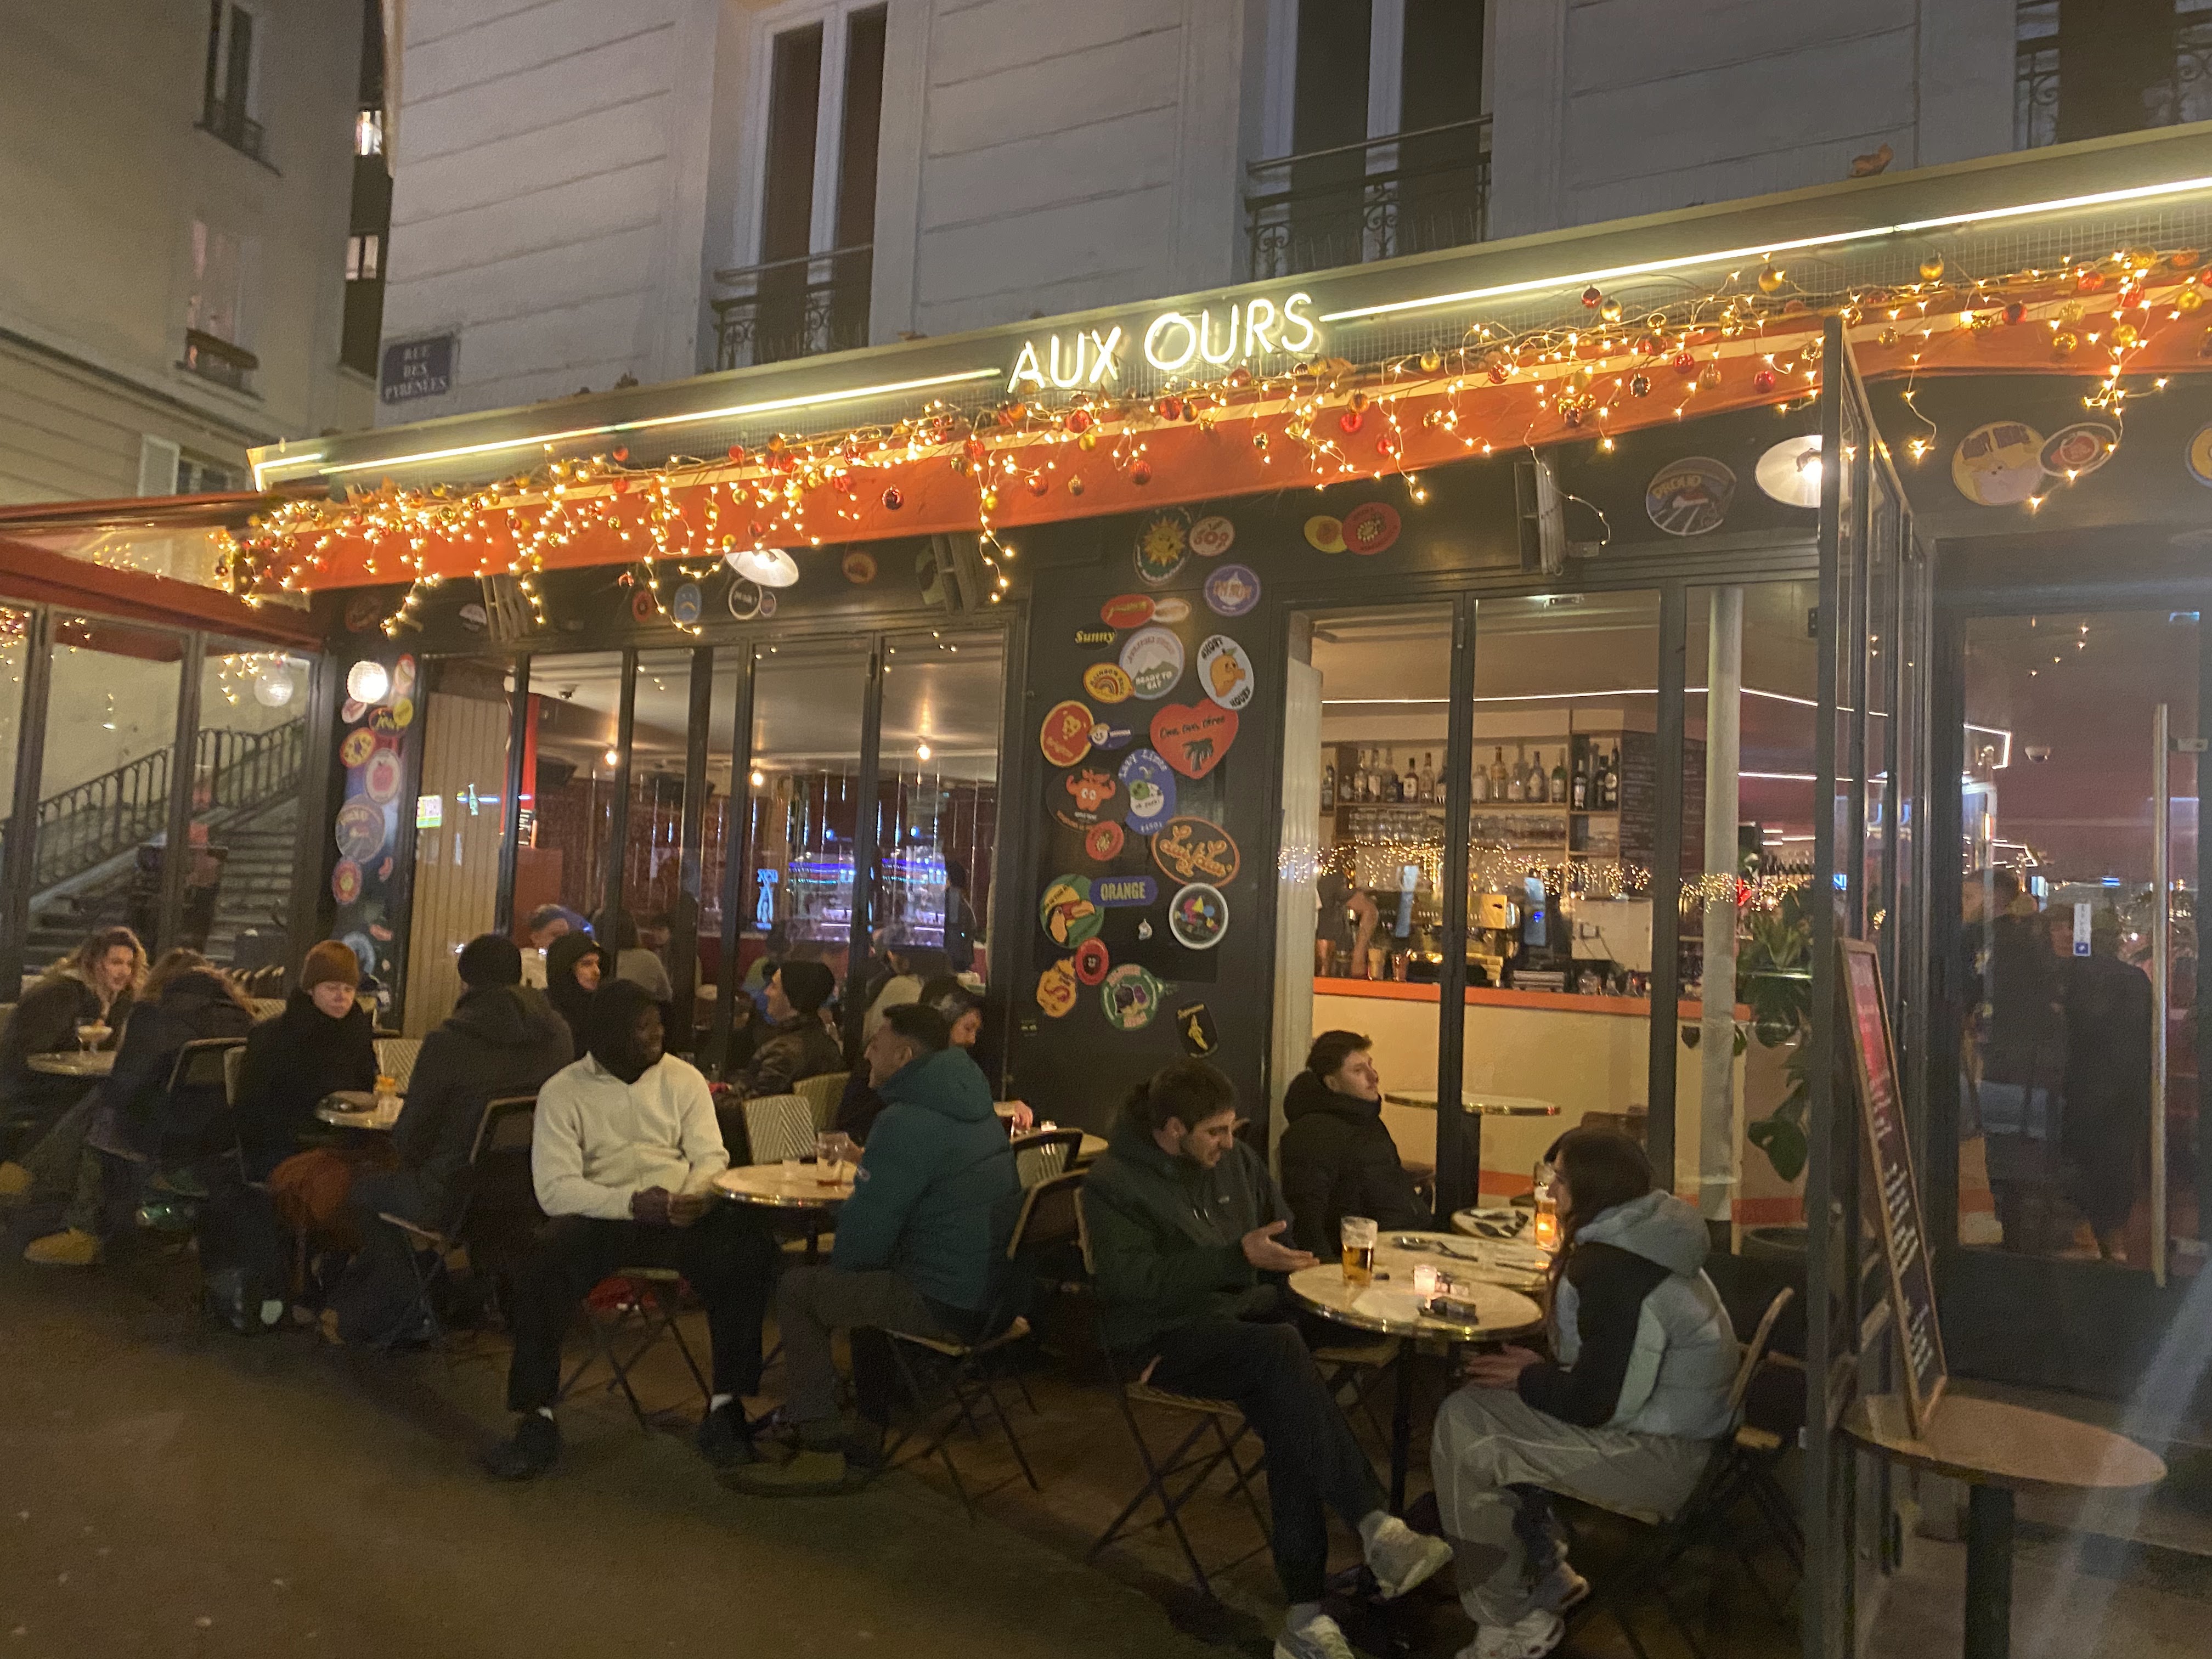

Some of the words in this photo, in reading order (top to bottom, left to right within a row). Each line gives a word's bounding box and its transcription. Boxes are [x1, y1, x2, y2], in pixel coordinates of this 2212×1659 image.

[1007, 326, 1122, 393] AUX
[1144, 292, 1314, 371] OURS
[1075, 631, 1115, 645] Sunny
[1161, 671, 1172, 680] TO
[1101, 882, 1146, 901] ORANGE
